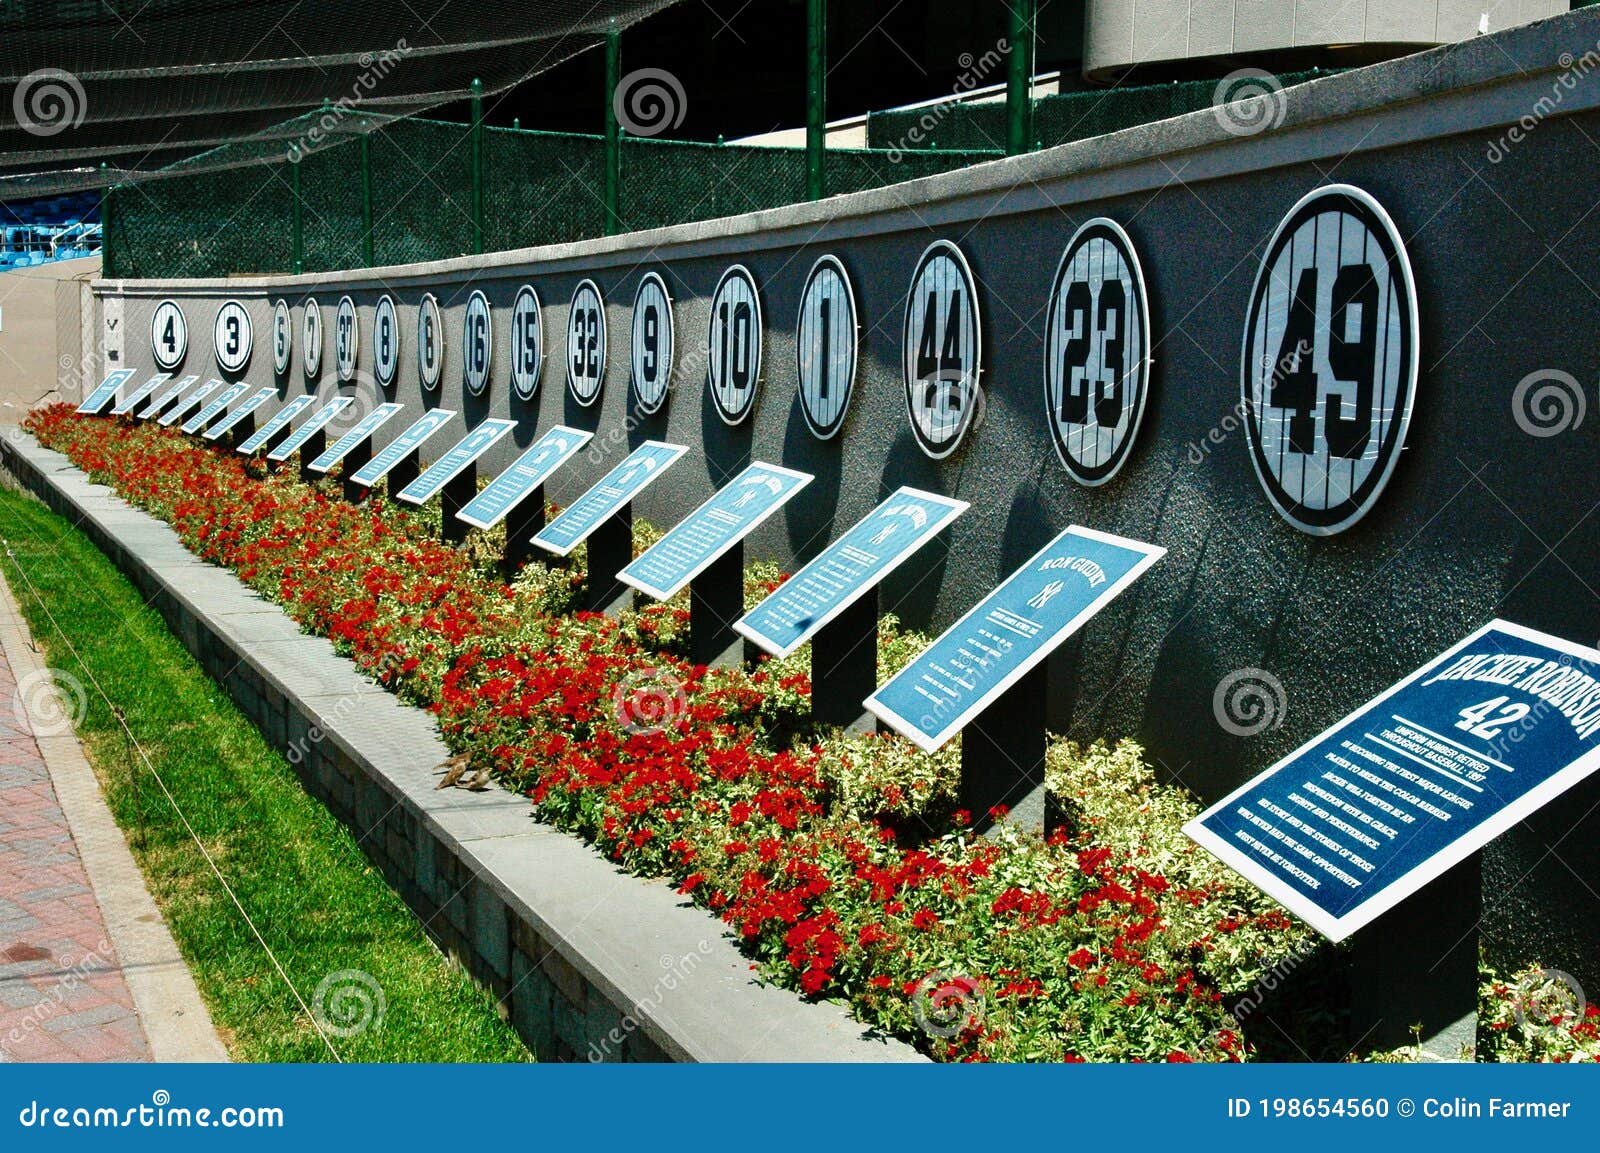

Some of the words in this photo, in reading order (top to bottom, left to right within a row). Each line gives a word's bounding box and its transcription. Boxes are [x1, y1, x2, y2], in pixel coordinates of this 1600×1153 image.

[162, 315, 177, 353] 4
[226, 316, 240, 356] 3
[277, 316, 285, 357] 5
[308, 316, 315, 360] 7
[339, 315, 352, 362] 37
[382, 316, 390, 366] 8
[425, 315, 434, 369] 8
[468, 314, 486, 373] 16
[517, 311, 536, 375] 15
[574, 308, 598, 378] 32
[643, 305, 659, 382] 9
[719, 301, 751, 390] 10
[820, 298, 830, 399] 1
[917, 289, 962, 411] 44
[1061, 279, 1126, 429] 23
[1270, 263, 1380, 461] 49
[1038, 556, 1076, 571] RON
[1071, 557, 1106, 588] GUIDRY
[1421, 653, 1545, 687] JACKIE
[1454, 695, 1531, 741] 42
[1381, 729, 1429, 758] THROUGHOUT
[1466, 771, 1486, 782] 1997
[1395, 726, 1428, 746] UNIFORM
[1424, 740, 1458, 760] NUMBER
[1455, 754, 1489, 775] RETIRED
[1384, 761, 1400, 772] THE
[1396, 768, 1419, 781] FIRST
[1415, 778, 1443, 794] MAJOR
[1440, 790, 1473, 809] LEAGUE
[1393, 788, 1420, 804] COLOR
